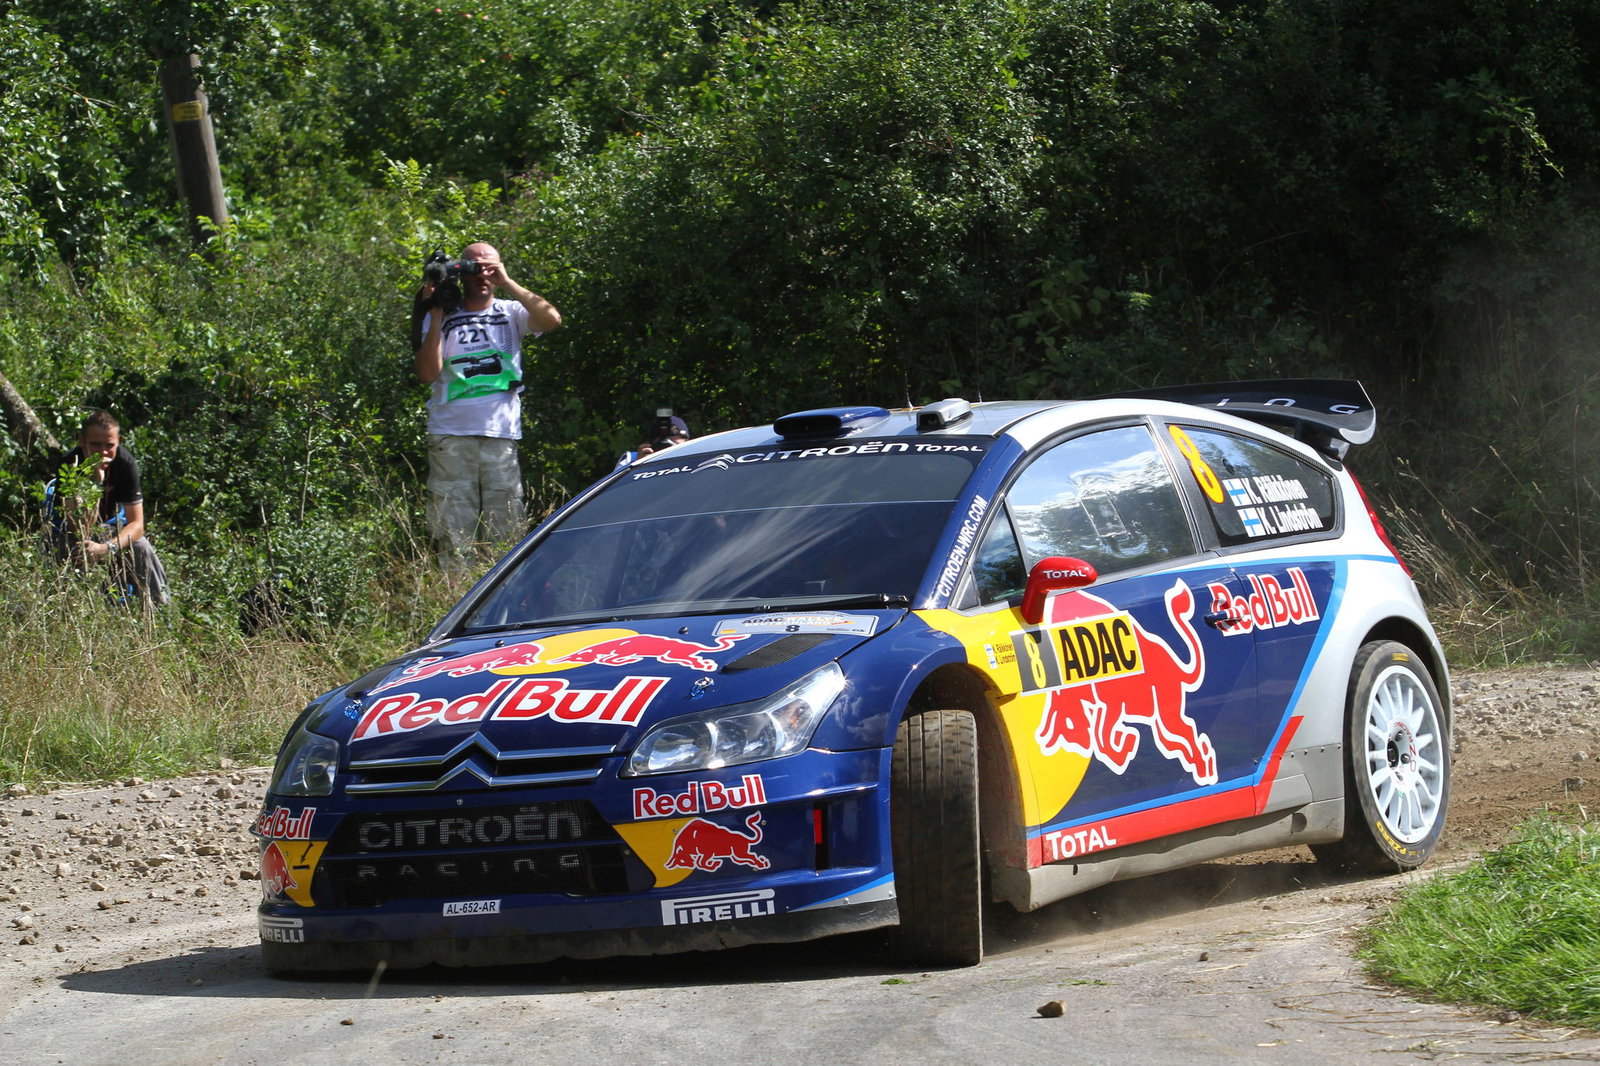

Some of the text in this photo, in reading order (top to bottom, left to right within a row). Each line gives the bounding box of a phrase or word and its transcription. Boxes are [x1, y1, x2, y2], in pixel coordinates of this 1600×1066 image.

[458, 329, 489, 344] 221
[633, 465, 692, 480] TOTAL
[915, 443, 983, 452] TOTAL
[1168, 424, 1224, 504] 8
[1241, 478, 1263, 504] K.
[1256, 507, 1277, 535] K.
[938, 495, 988, 597] CITROEN-WRC.COM
[1043, 569, 1087, 579] TOTAL
[1207, 567, 1320, 636] Red Bull
[1024, 619, 1137, 688] 8 ADAC
[347, 676, 671, 745] Red Bull
[633, 774, 767, 819] Red Bull
[274, 807, 317, 839] Bull
[1046, 825, 1117, 860] TOTAL
[447, 901, 496, 914] AL-652-AR
[660, 889, 776, 926] PIRELLI
